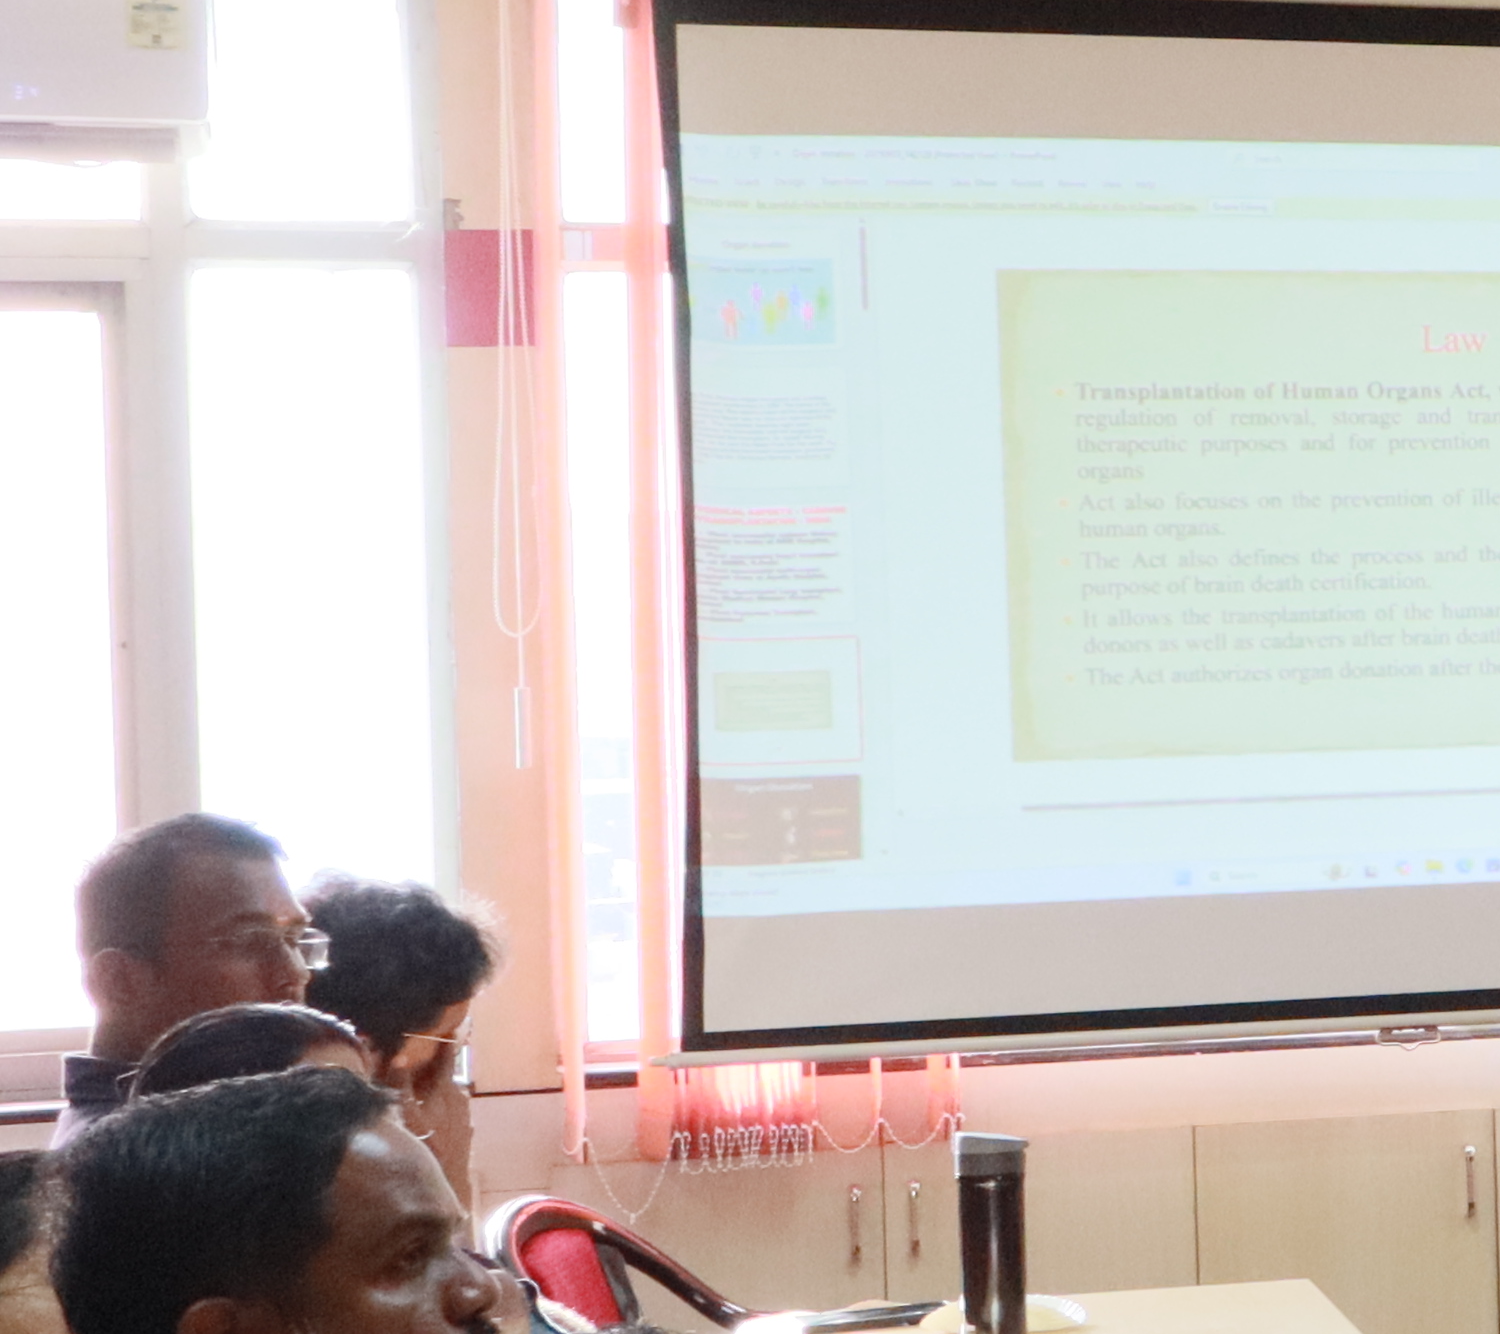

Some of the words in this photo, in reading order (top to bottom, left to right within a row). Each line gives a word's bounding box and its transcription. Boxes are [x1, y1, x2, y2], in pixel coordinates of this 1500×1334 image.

[1424, 324, 1489, 353] Law
[1073, 382, 1246, 406] Transplantation
[1252, 381, 1276, 400] of
[1281, 381, 1359, 400] Human
[1365, 381, 1443, 405] Organs
[1074, 409, 1177, 433] regulation
[1192, 408, 1216, 427] of
[1331, 407, 1401, 431] storage
[1416, 407, 1451, 426] and
[1075, 435, 1188, 459] therapeutic
[1199, 437, 1288, 458] purposes
[1299, 433, 1335, 452] and
[1347, 433, 1376, 452] for
[1387, 432, 1490, 456] prevention
[1076, 464, 1144, 485] organs
[1078, 493, 1115, 512] Act
[1123, 492, 1165, 511] also
[1174, 491, 1249, 510] focuses
[1256, 494, 1283, 510] on
[1290, 490, 1321, 509] the
[1330, 489, 1433, 513] prevention
[1441, 489, 1464, 508] of
[1078, 519, 1148, 538] human
[1079, 550, 1119, 569] The
[1131, 550, 1167, 569] Act
[1177, 549, 1218, 568] also
[1228, 548, 1300, 567] defines
[1309, 547, 1340, 566] the
[1351, 549, 1424, 570] process
[1433, 545, 1468, 564] and
[1080, 580, 1159, 601] purpose
[1165, 576, 1192, 595] of
[1193, 575, 1245, 594] brain
[1250, 574, 1304, 593] death
[1082, 609, 1097, 628] It
[1106, 608, 1173, 627] allows
[1180, 607, 1211, 626] the
[1220, 605, 1366, 629] transplantation
[1374, 603, 1396, 622] of
[1403, 602, 1433, 621] the
[1083, 635, 1152, 654] donors
[1158, 637, 1179, 653] as
[1185, 633, 1227, 652] well
[1233, 635, 1254, 651] as
[1259, 630, 1345, 649] cadavers
[1351, 629, 1395, 648] after
[1400, 627, 1450, 646] brain
[1085, 666, 1123, 685] The
[1129, 666, 1163, 685] Act
[1170, 664, 1272, 683] authorizes
[1277, 665, 1332, 686] organ
[1339, 660, 1423, 679] donation
[1429, 658, 1471, 677] after
